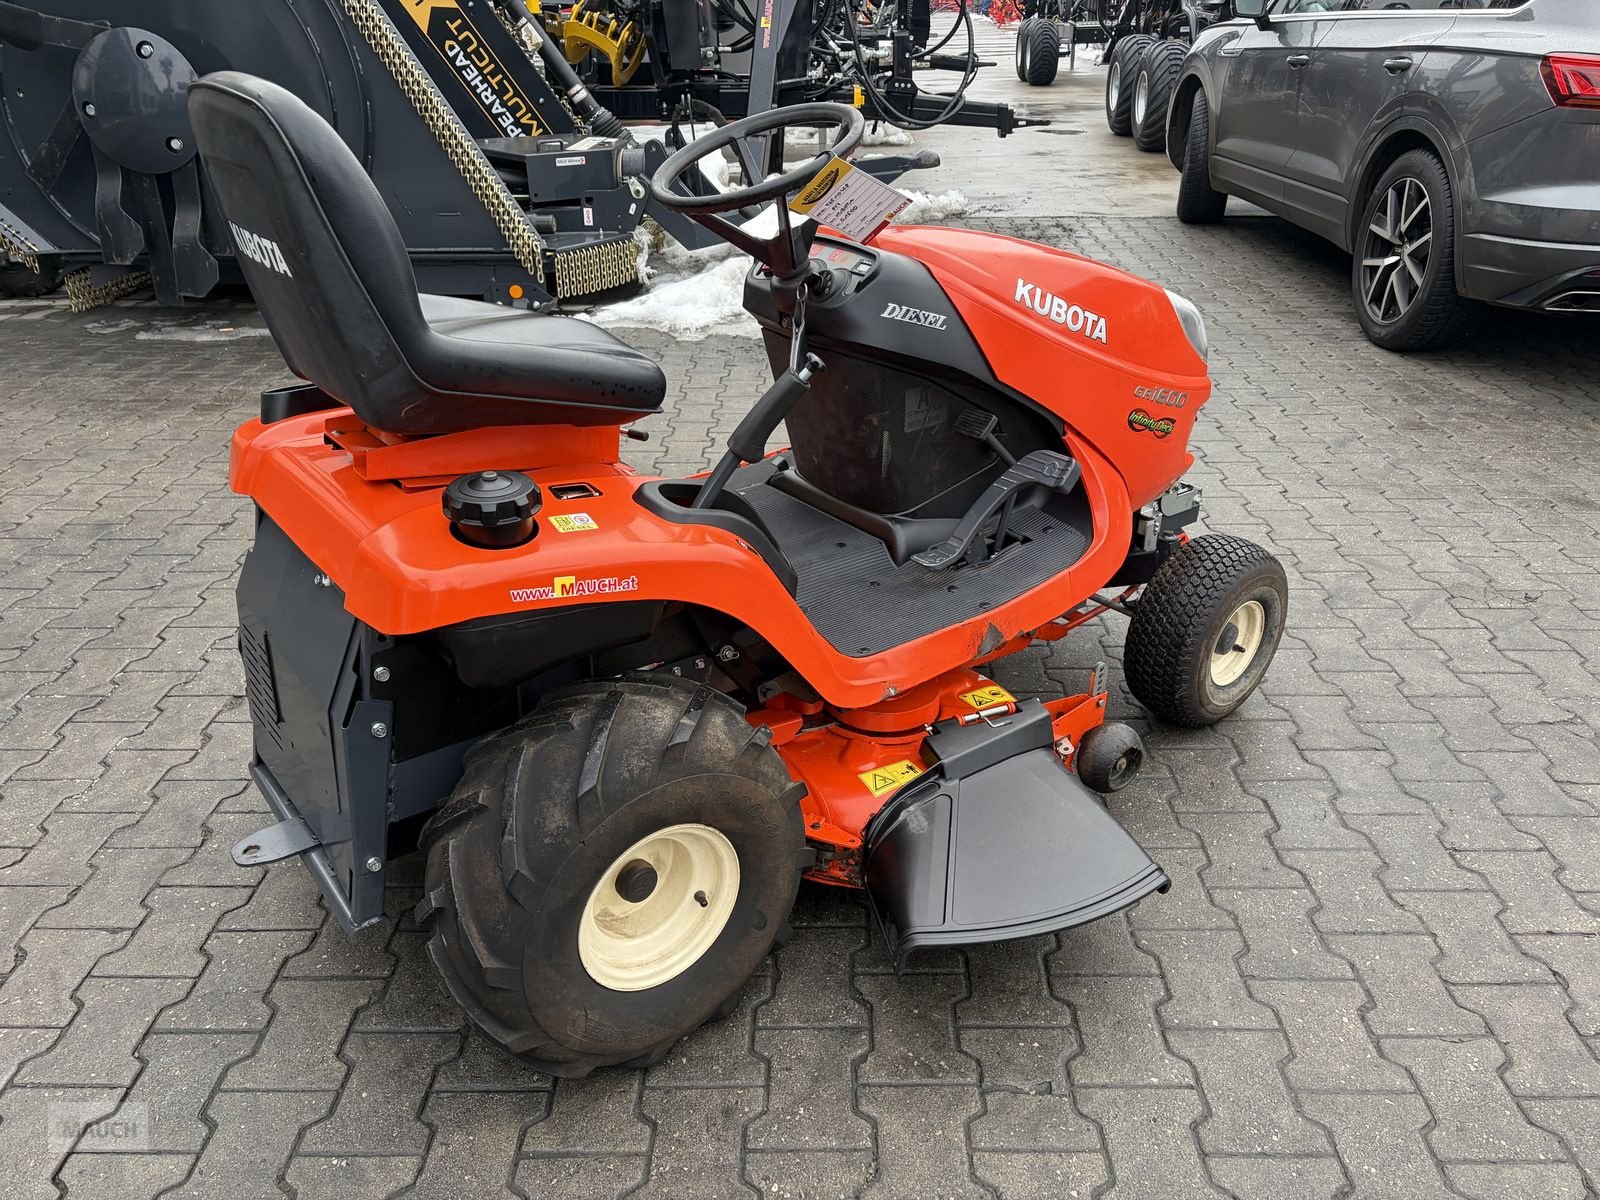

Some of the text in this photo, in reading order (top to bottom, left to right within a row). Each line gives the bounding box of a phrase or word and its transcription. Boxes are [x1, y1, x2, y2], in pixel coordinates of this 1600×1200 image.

[444, 40, 526, 138] PEARHEAD
[445, 18, 543, 136] MULTICUT
[886, 200, 908, 220] MAUCH
[227, 219, 294, 278] KUBOTA
[879, 301, 948, 331] DIESEL
[1013, 277, 1108, 345] KUBOTA
[1129, 411, 1157, 432] Infinity
[561, 524, 594, 532] DIESEL
[510, 575, 638, 602] www.MAUCH.at
